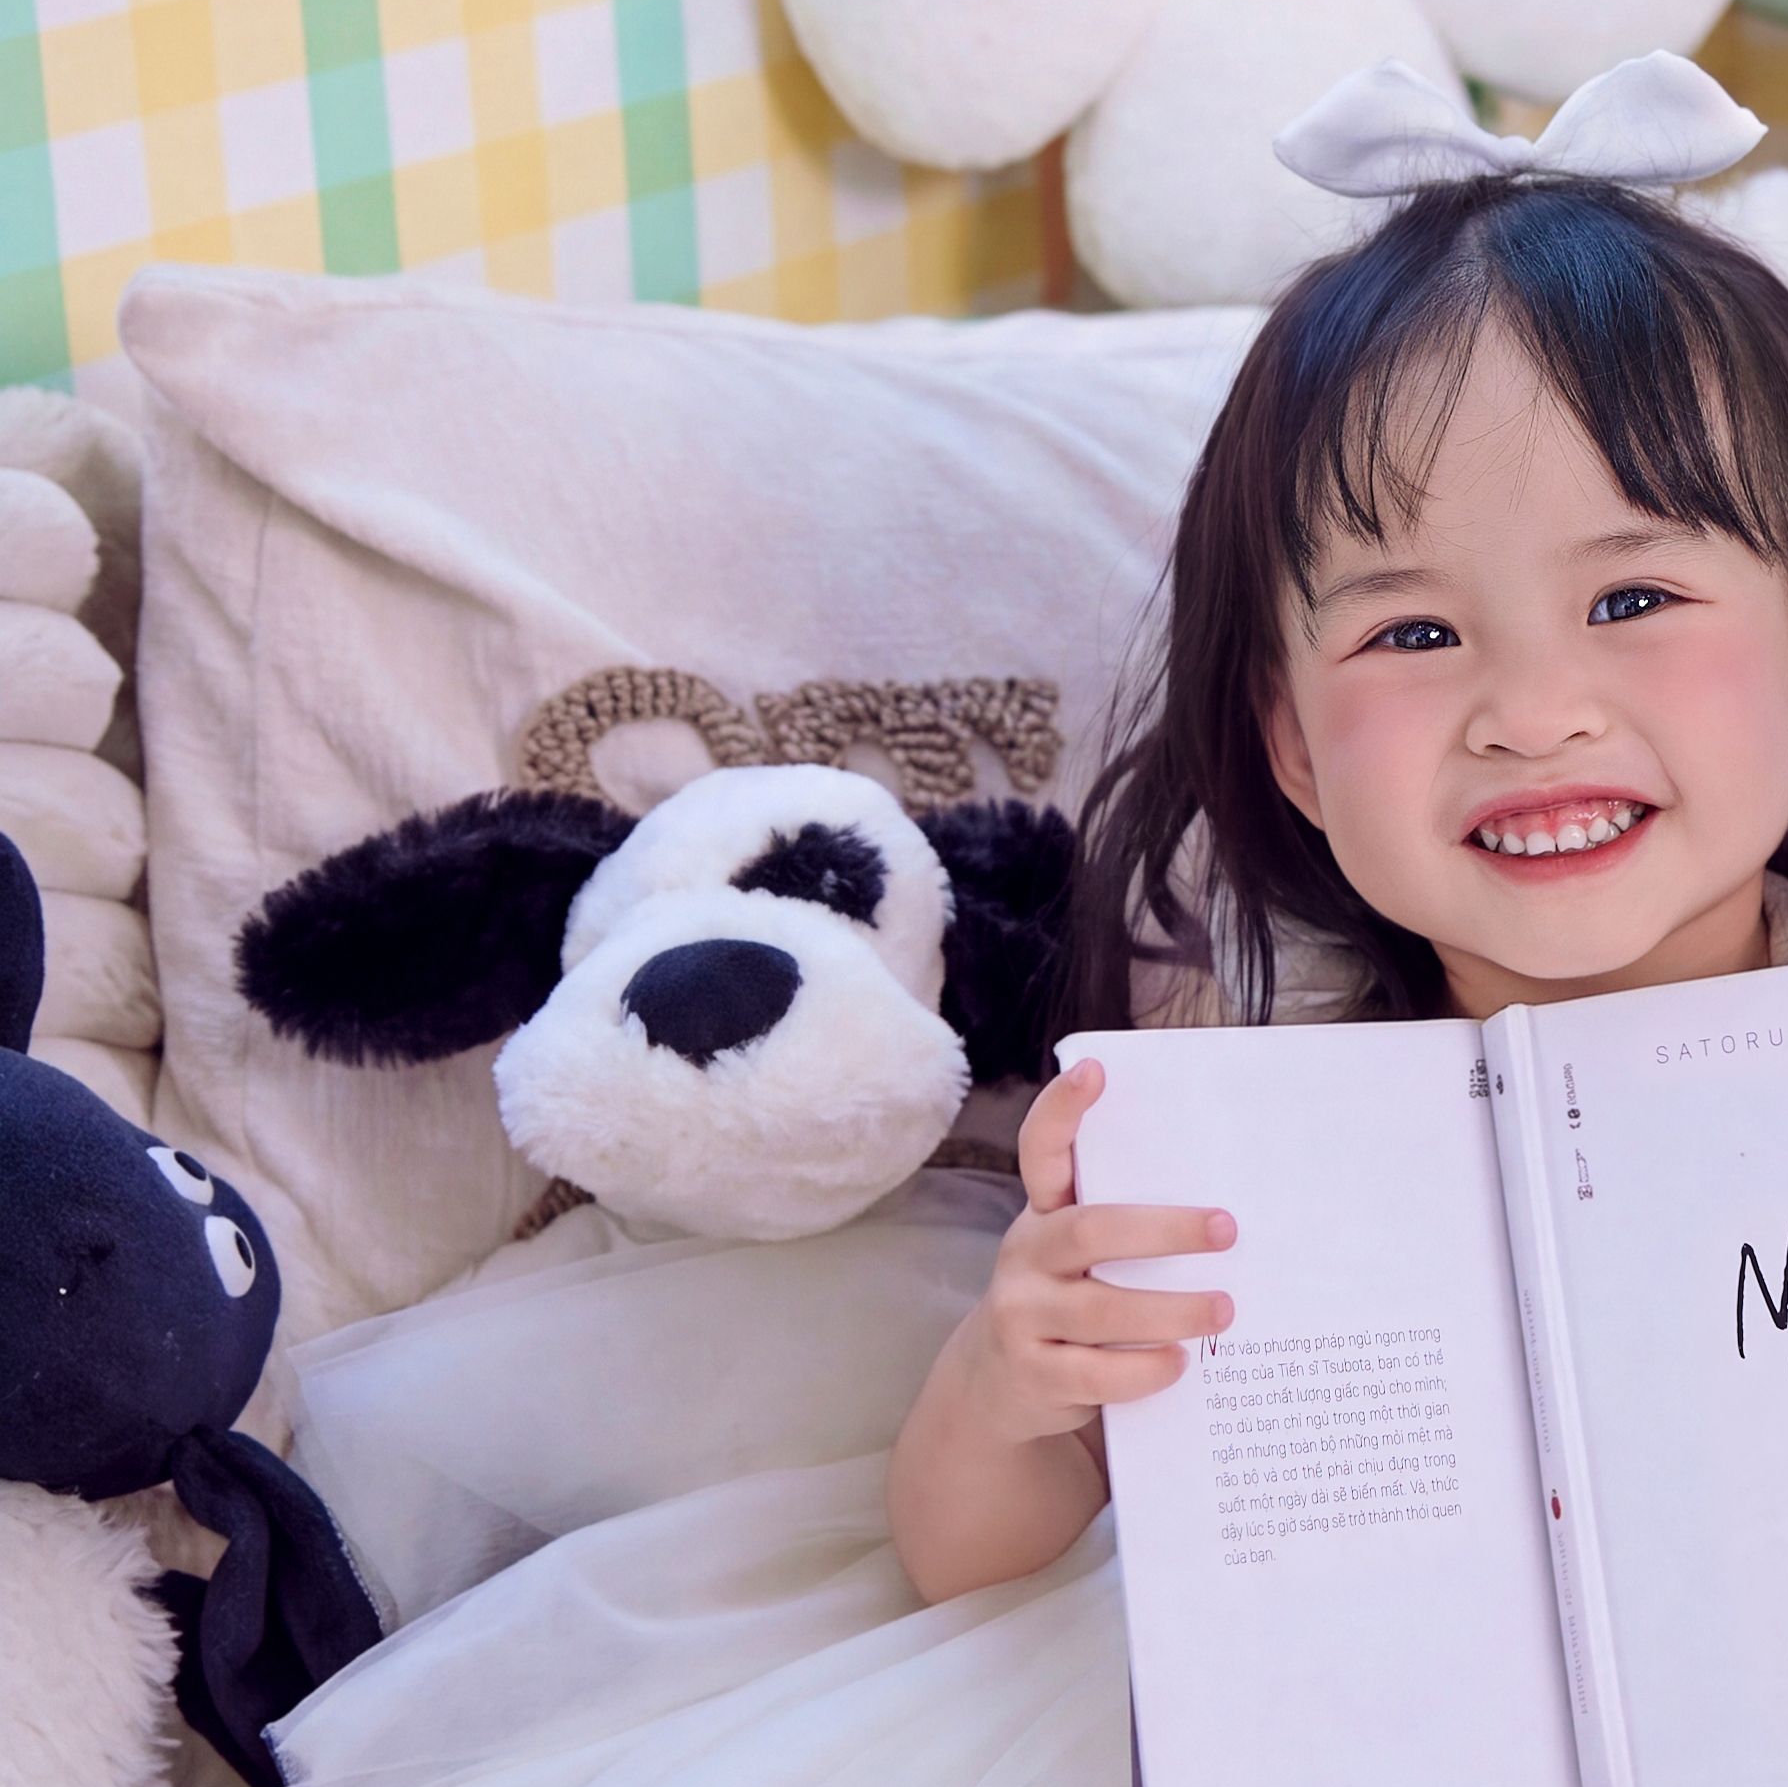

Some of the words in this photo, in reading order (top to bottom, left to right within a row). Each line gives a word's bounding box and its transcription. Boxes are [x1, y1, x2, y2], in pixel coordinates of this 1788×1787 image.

[1655, 1027, 1785, 1065] SATORU
[1238, 1339, 1261, 1356] vào
[1314, 1332, 1345, 1352] pháp
[1348, 1330, 1372, 1350] ngủ
[1375, 1331, 1406, 1348] ngon
[1203, 1368, 1212, 1384] 5
[1251, 1363, 1274, 1381] của
[1277, 1359, 1305, 1378] Tiến
[1308, 1360, 1319, 1376] sĩ
[1377, 1355, 1401, 1373] bạn
[1404, 1351, 1420, 1368] có
[1423, 1348, 1444, 1366] thể
[1206, 1392, 1238, 1412] nâng
[1240, 1394, 1263, 1408] cao
[1266, 1386, 1294, 1405] chất
[1334, 1381, 1360, 1402] giấc
[1362, 1379, 1386, 1399] ngủ
[1389, 1378, 1412, 1395] cho
[1209, 1421, 1233, 1436] cho
[1236, 1417, 1253, 1434] dù
[1256, 1416, 1280, 1435] bạn
[1306, 1410, 1329, 1430] ngủ
[1369, 1404, 1394, 1424] một
[1397, 1402, 1421, 1420] thời
[1424, 1401, 1450, 1420] gian
[1212, 1443, 1244, 1465] ngắn
[1289, 1438, 1318, 1455] toàn
[1320, 1434, 1337, 1454] bộ
[1407, 1426, 1431, 1446] mệt
[1434, 1424, 1453, 1441] mà
[1215, 1471, 1239, 1488] não
[1243, 1468, 1259, 1487] bộ
[1263, 1467, 1278, 1483] và
[1282, 1467, 1298, 1482] cơ
[1302, 1460, 1323, 1480] thể
[1327, 1459, 1353, 1480] phải
[1358, 1457, 1384, 1476] chịu
[1388, 1456, 1420, 1474] đựng
[1218, 1495, 1246, 1514] suốt
[1249, 1493, 1275, 1513] một
[1278, 1490, 1307, 1510] ngày
[1311, 1488, 1329, 1505] dài
[1333, 1486, 1347, 1503] sẽ
[1350, 1482, 1377, 1501] biến
[1431, 1475, 1459, 1493] thức
[1221, 1522, 1243, 1542] dậy
[1245, 1521, 1265, 1537] lúc
[1267, 1519, 1276, 1535] 5
[1278, 1516, 1297, 1537] giờ
[1299, 1514, 1329, 1533] sáng
[1331, 1512, 1346, 1529] sẽ
[1348, 1509, 1366, 1527] trở
[1432, 1503, 1462, 1520] quen
[1224, 1548, 1247, 1566] của
